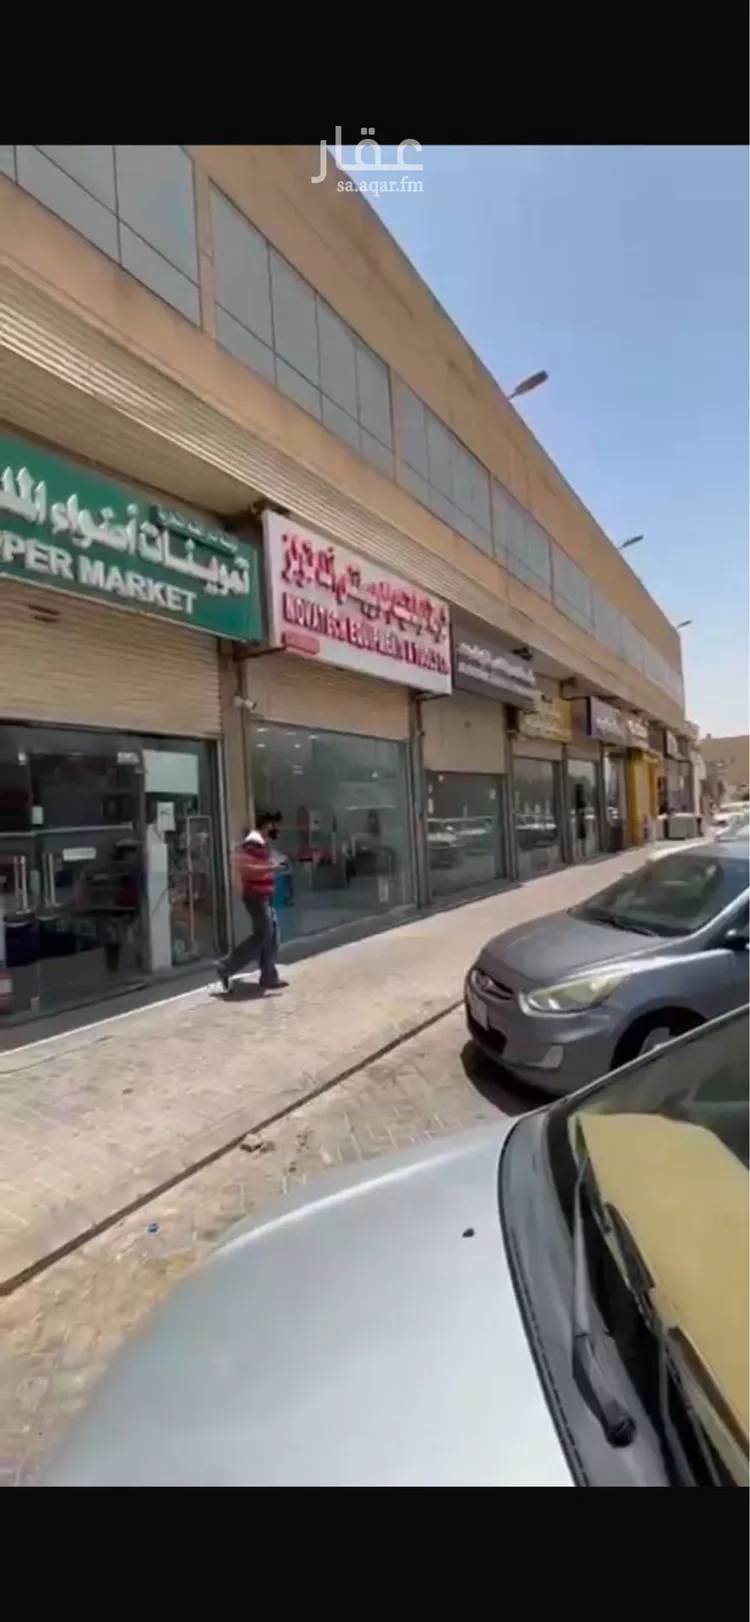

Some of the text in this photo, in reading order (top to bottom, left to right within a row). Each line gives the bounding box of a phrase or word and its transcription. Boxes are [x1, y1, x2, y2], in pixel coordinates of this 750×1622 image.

[51, 493, 139, 555] أضواء
[139, 520, 250, 596] تموينات
[0, 529, 198, 614] PER MARKET
